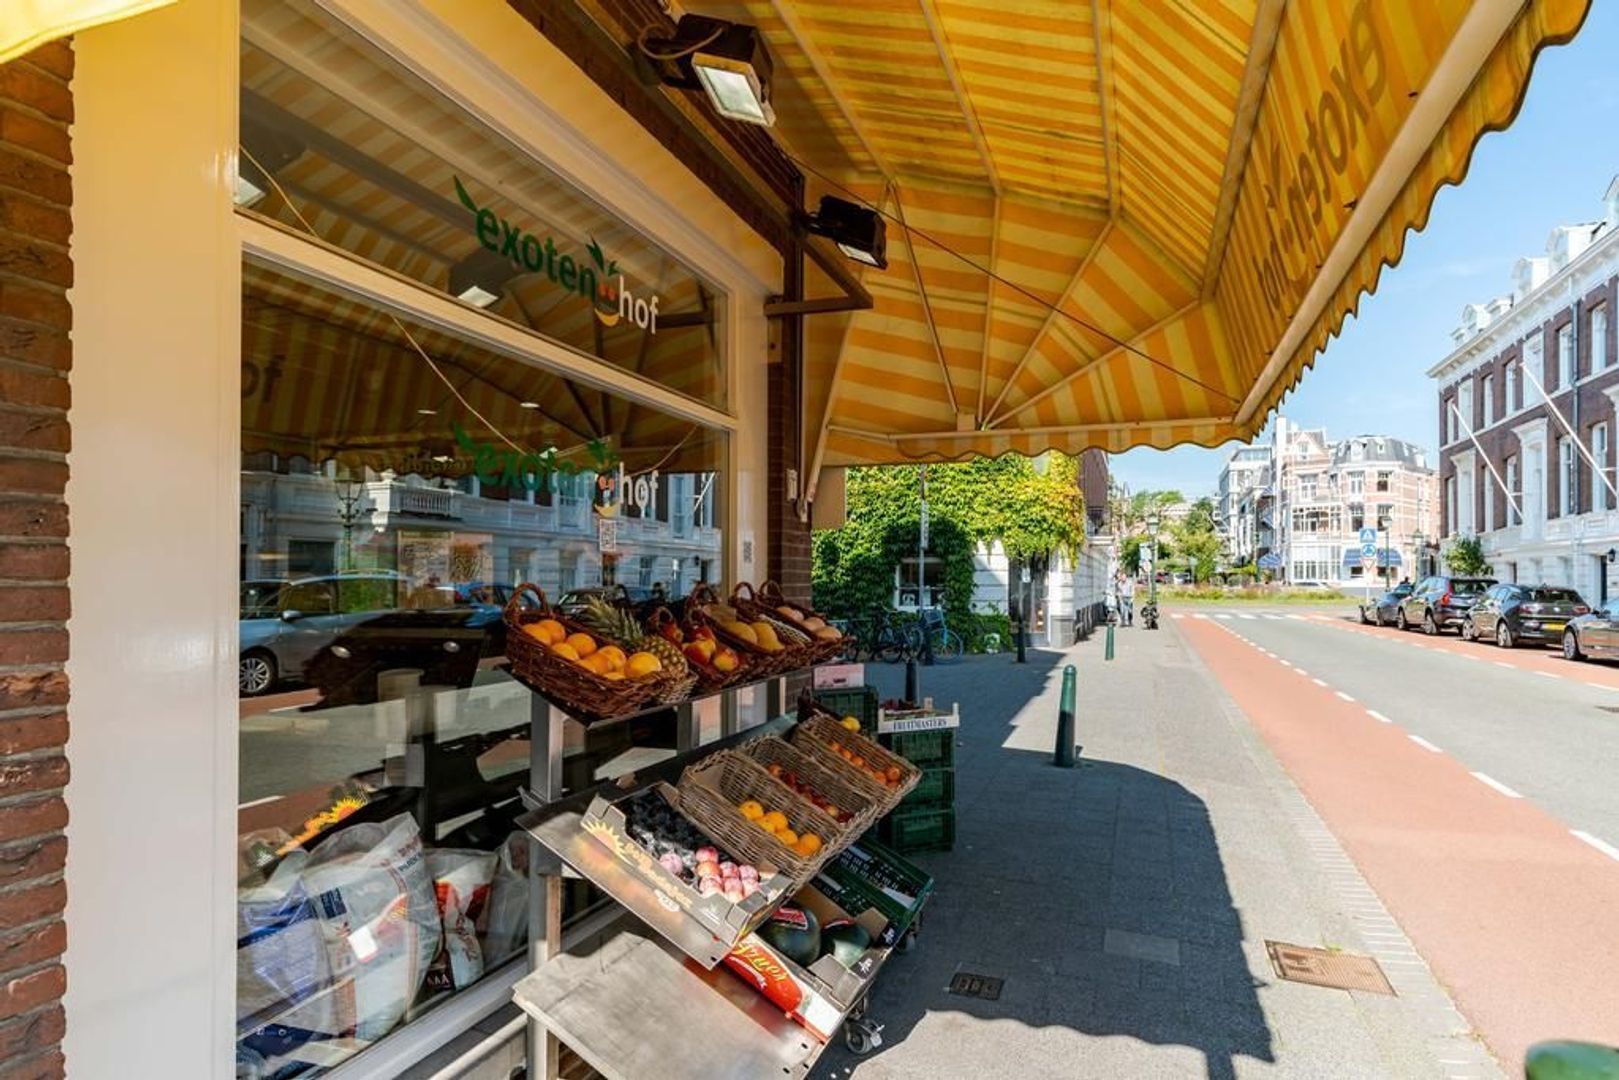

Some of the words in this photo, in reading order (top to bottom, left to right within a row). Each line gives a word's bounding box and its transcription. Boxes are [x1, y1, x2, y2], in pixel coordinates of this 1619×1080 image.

[475, 207, 597, 301] exoten
[618, 274, 659, 334] hof
[618, 461, 659, 507] hof
[893, 715, 948, 731] FRUITMASTERS
